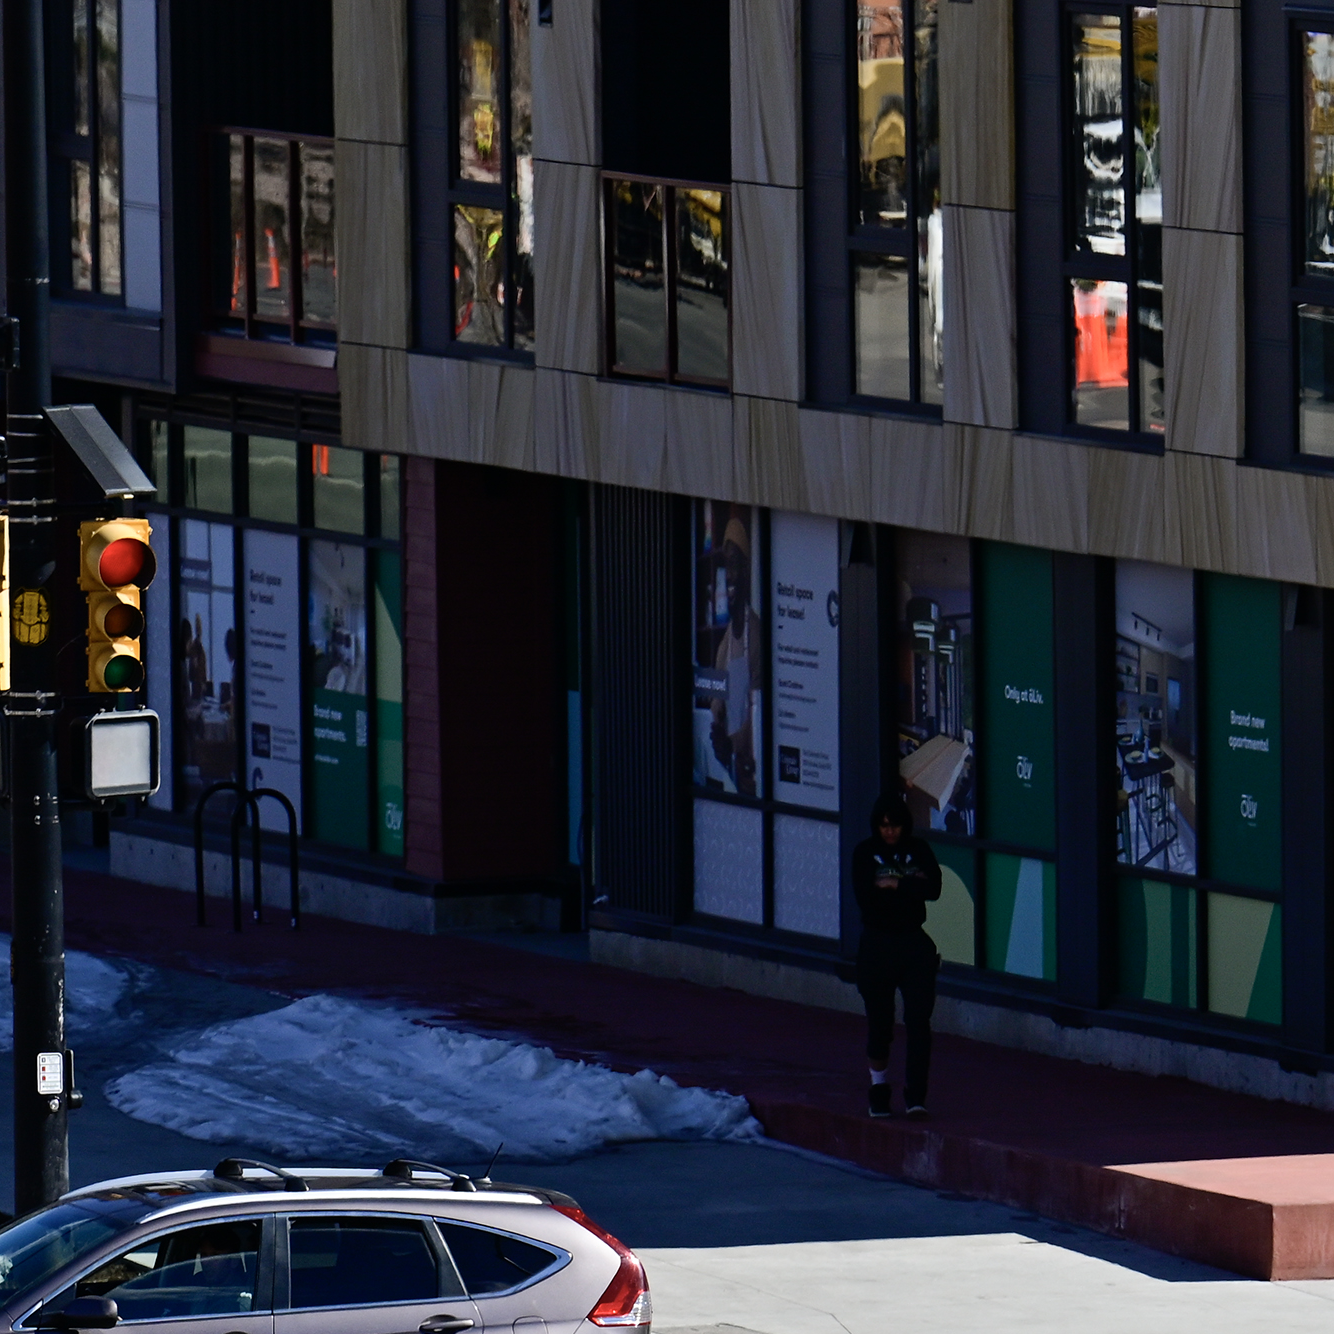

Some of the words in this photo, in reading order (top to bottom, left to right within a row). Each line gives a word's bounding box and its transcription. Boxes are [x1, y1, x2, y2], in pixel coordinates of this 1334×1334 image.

[1004, 684, 1020, 704] Only
[1020, 689, 1028, 702] at
[1230, 709, 1251, 727] Brand
[1251, 716, 1265, 729] new
